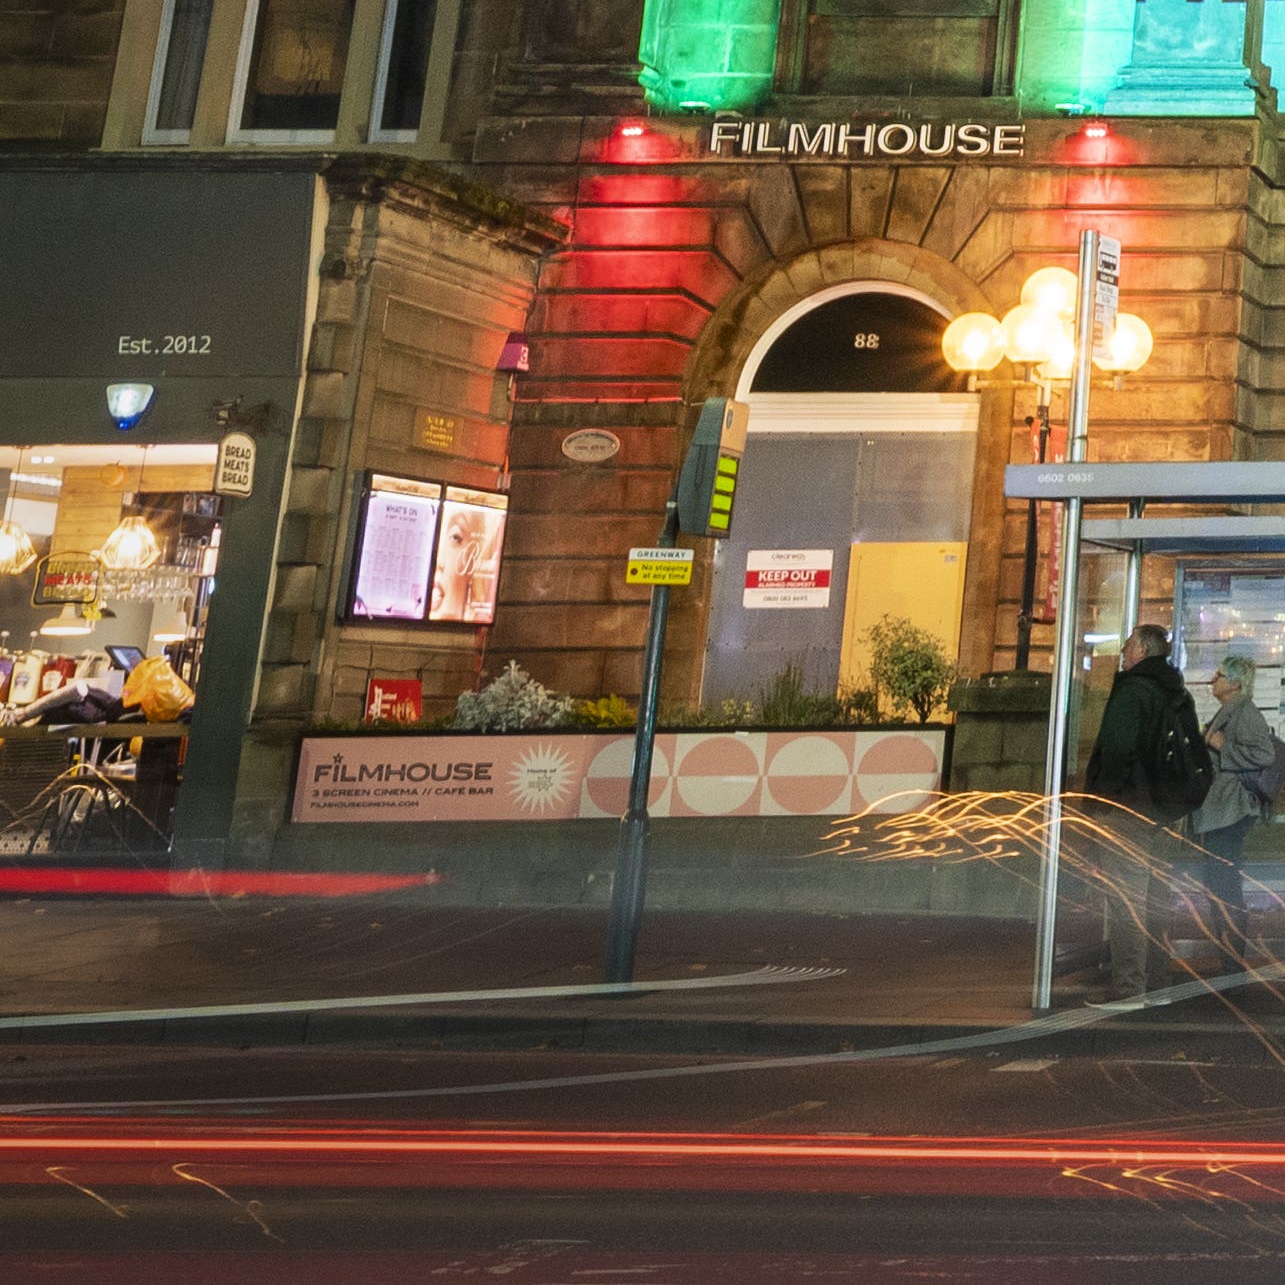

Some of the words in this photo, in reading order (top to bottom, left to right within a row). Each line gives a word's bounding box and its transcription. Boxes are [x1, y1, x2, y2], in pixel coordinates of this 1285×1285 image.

[710, 121, 1026, 158] FILMHOUSE
[854, 333, 880, 349] 88
[225, 445, 252, 460] BREAD
[224, 458, 250, 473] MEATS
[222, 471, 249, 486] BREAD
[637, 550, 687, 558] GREENWAY
[655, 564, 688, 573] stopping
[758, 570, 789, 581] KEEP
[790, 570, 818, 581] OUT
[313, 760, 494, 783] FILMHOUSE
[312, 788, 320, 798] 3
[322, 787, 371, 797] SCREEN
[373, 787, 419, 797] CINEMA
[468, 786, 494, 796] BAR
